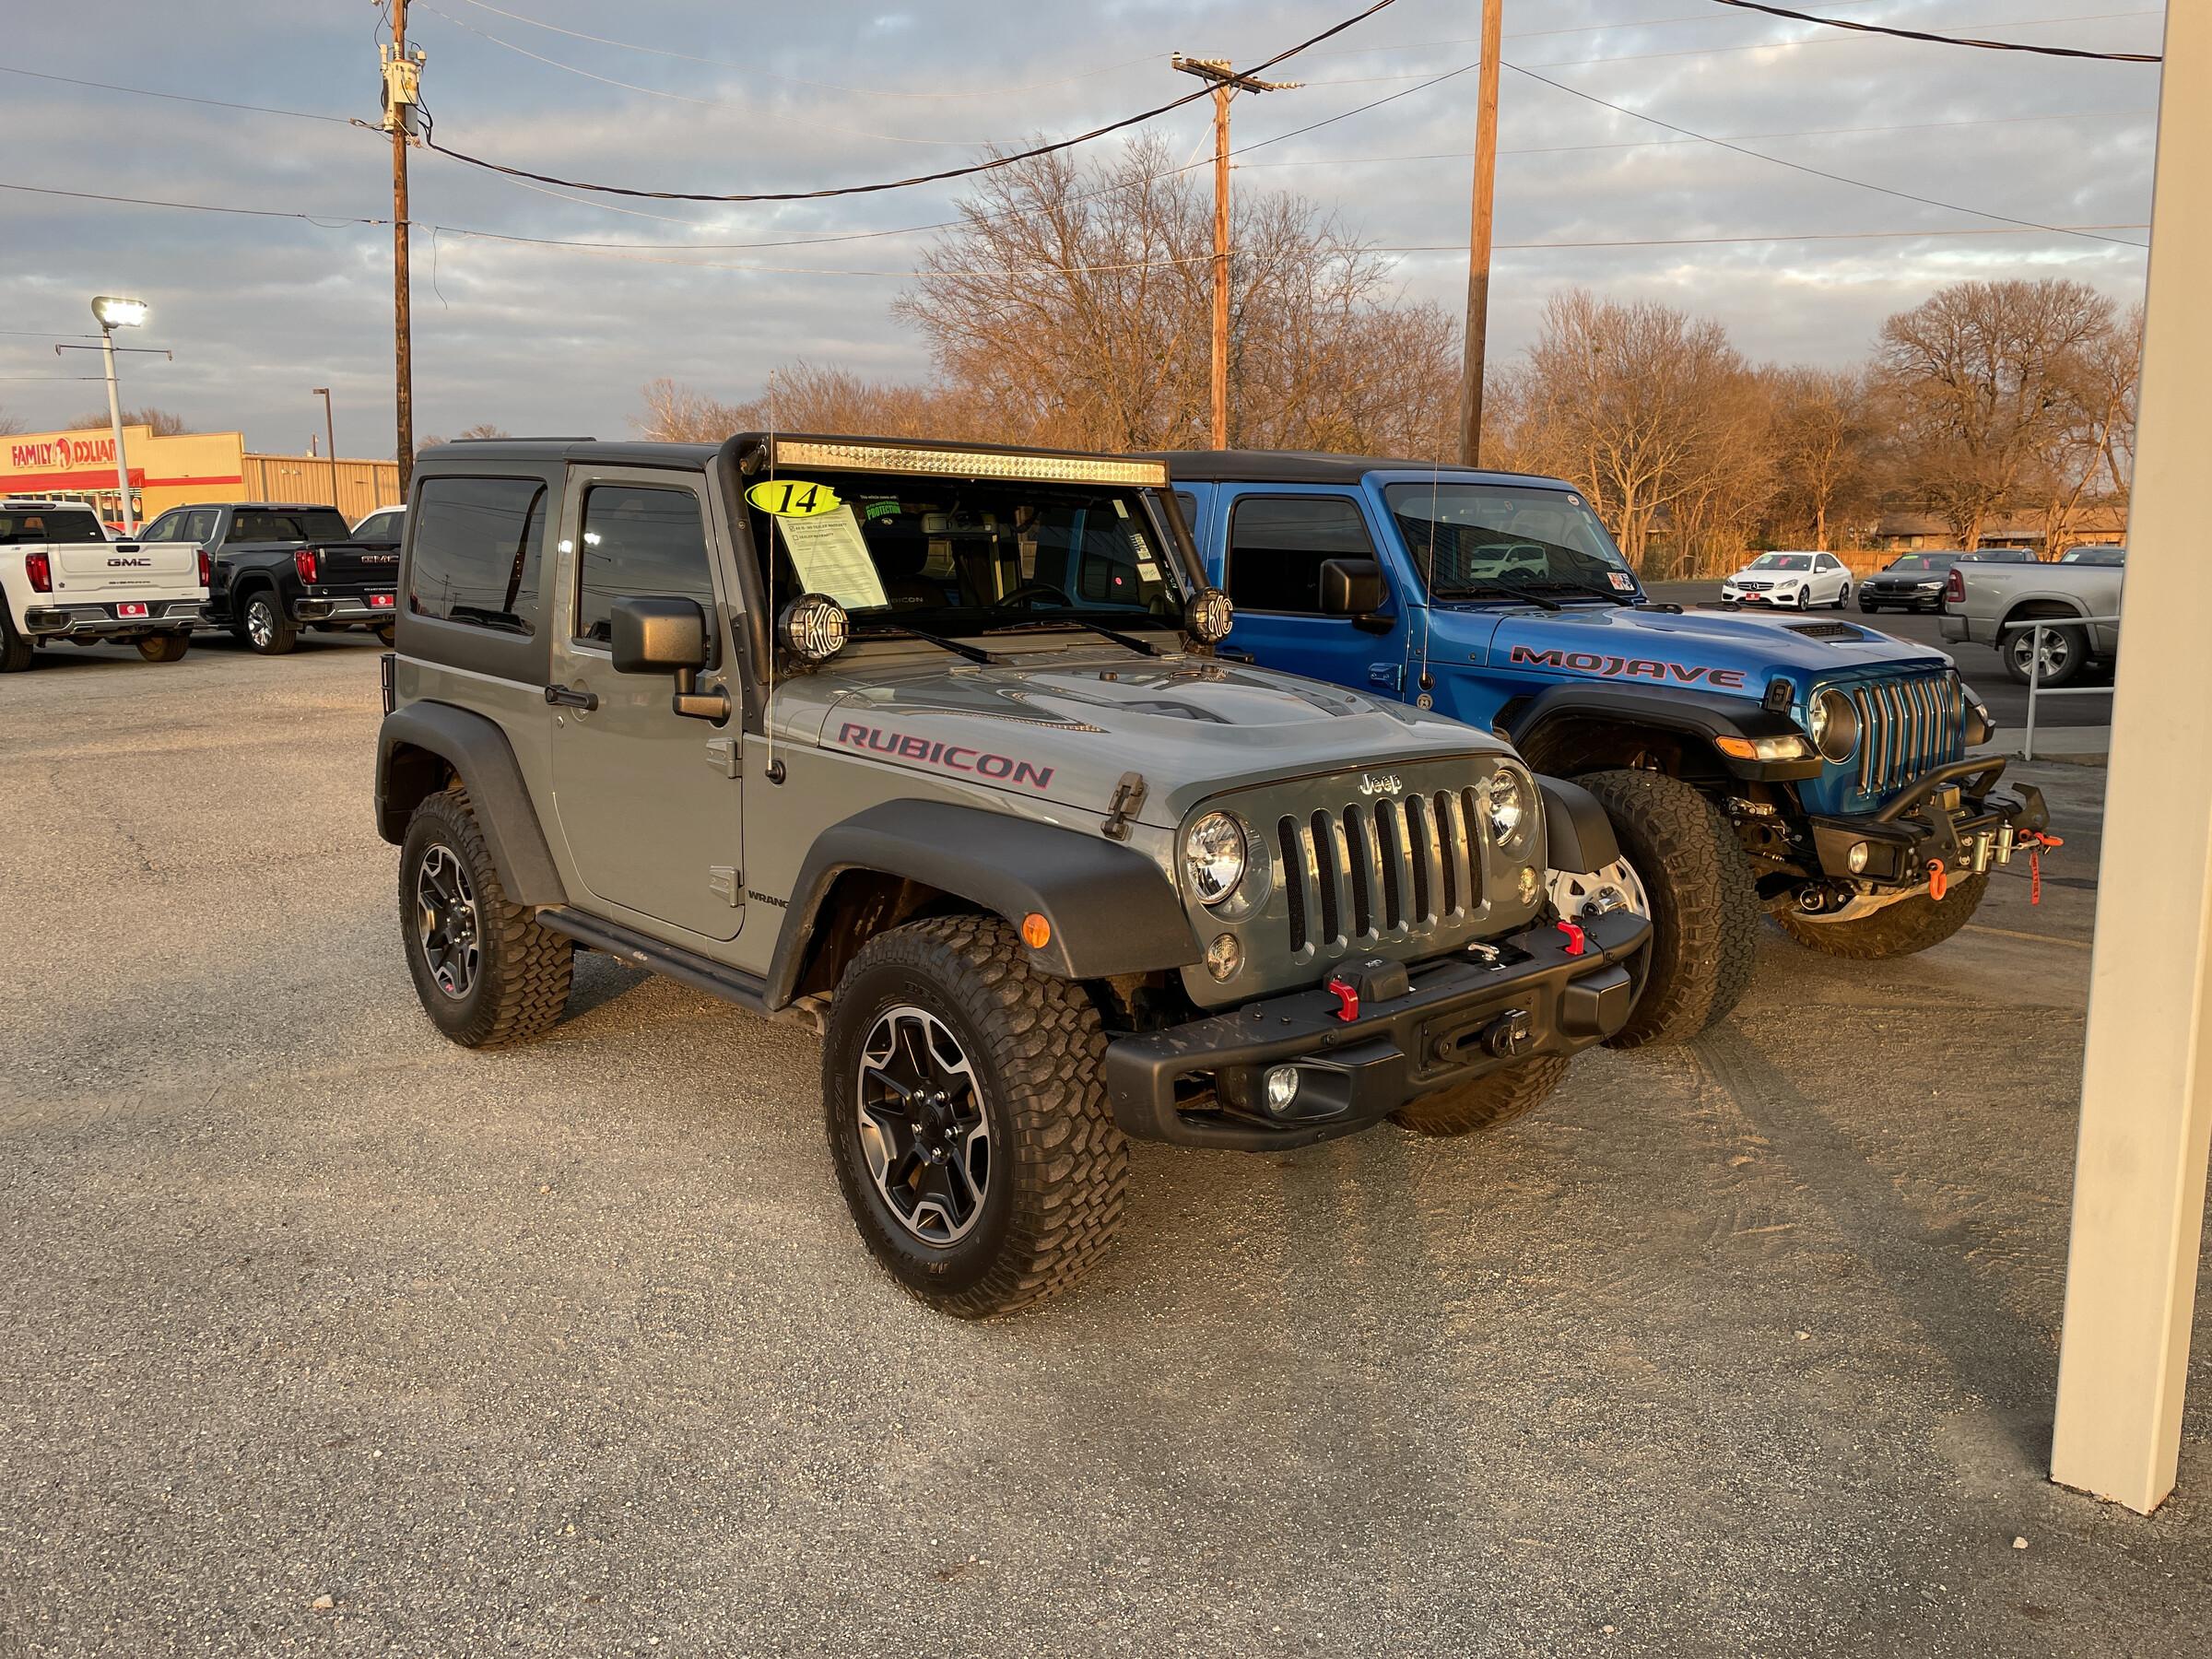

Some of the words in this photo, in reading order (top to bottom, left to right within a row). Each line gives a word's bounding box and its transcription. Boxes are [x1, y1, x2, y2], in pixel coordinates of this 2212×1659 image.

[12, 443, 52, 466] FAMILY
[777, 485, 818, 512] 14
[805, 604, 843, 655] KC
[1208, 595, 1233, 637] KC
[1511, 646, 1747, 689] MOJAVE
[838, 723, 1055, 790] RUBICON
[1359, 773, 1403, 794] Jeep
[748, 889, 790, 909] WRANG
